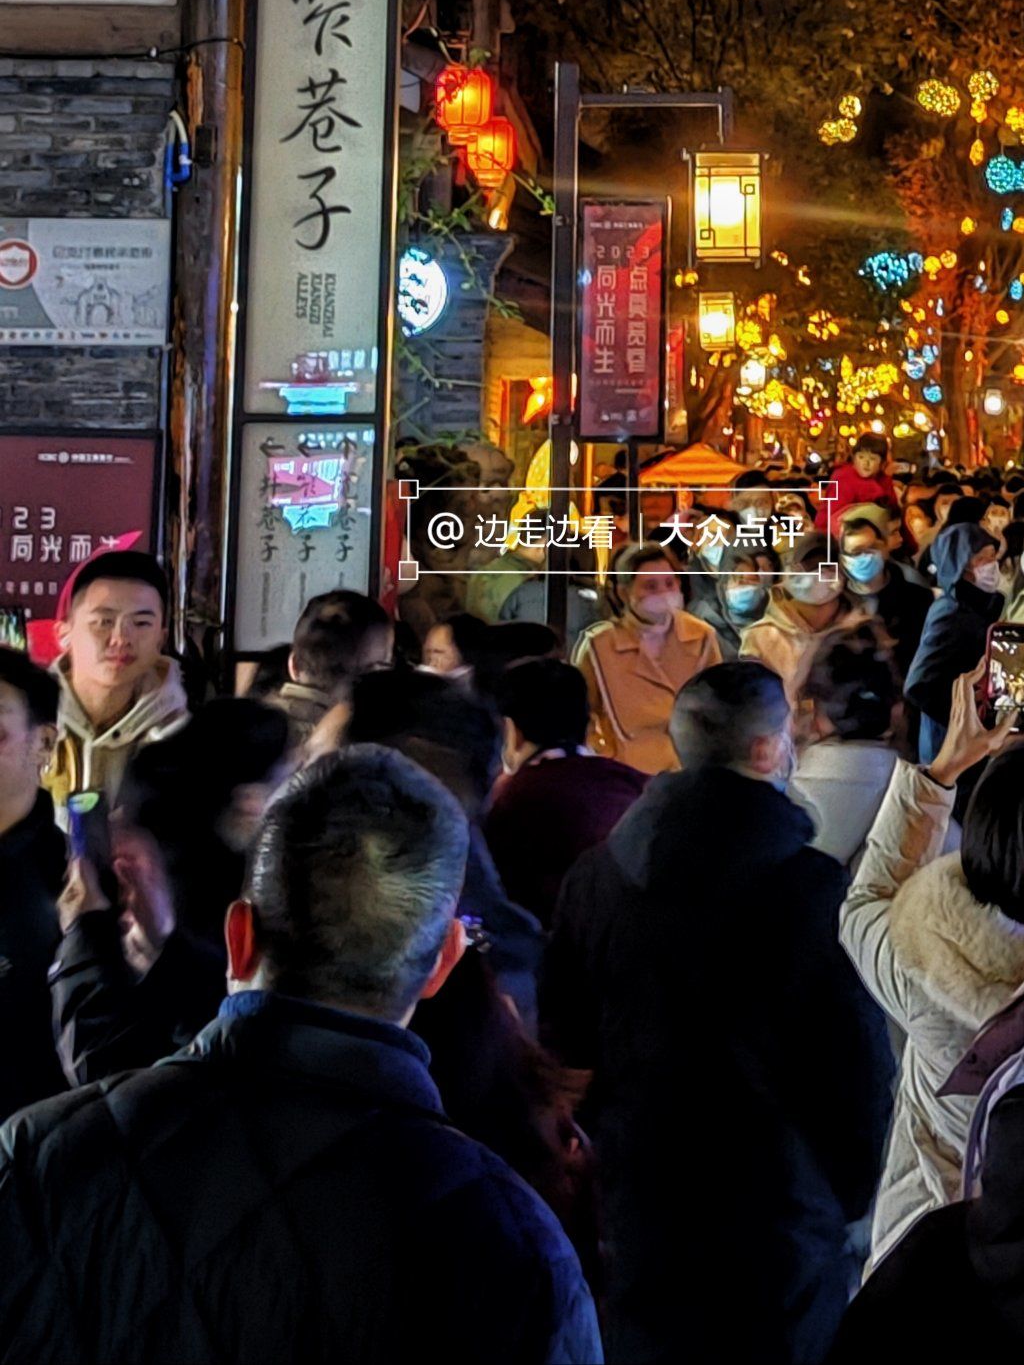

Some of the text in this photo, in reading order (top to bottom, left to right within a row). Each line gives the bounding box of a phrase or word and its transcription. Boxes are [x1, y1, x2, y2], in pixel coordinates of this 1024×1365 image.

[596, 245, 650, 259] 2023
[295, 271, 309, 320] ALLEYS
[309, 272, 322, 325] XIANGZI
[322, 272, 337, 338] KUANZHAI
[593, 264, 617, 374] 同光而生
